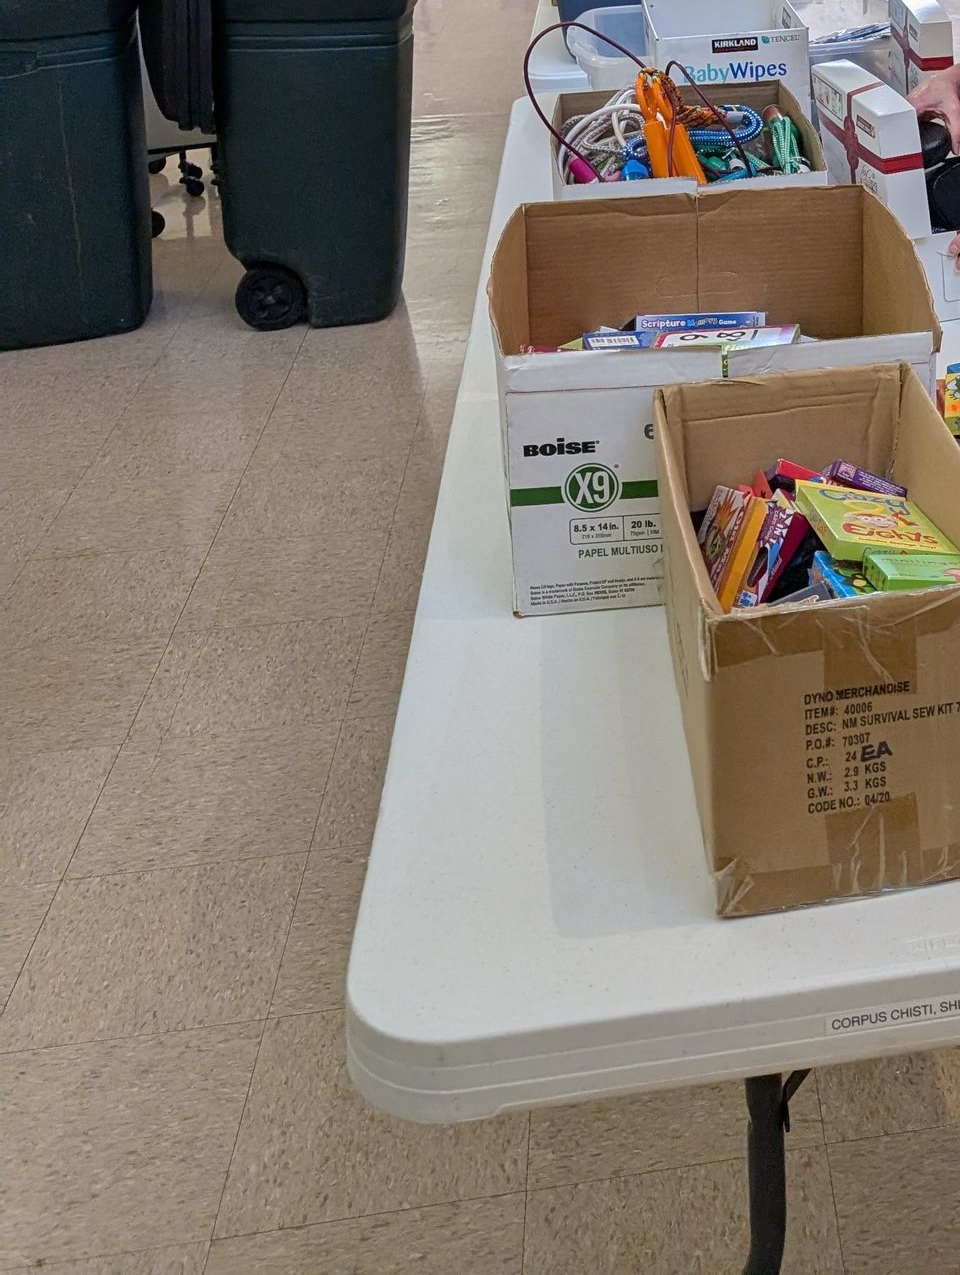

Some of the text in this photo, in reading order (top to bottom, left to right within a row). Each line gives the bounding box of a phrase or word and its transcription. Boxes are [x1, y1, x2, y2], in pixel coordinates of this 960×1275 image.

[713, 38, 756, 48] KIRKLAND
[642, 318, 686, 329] Scripture
[718, 318, 737, 326] Game
[574, 471, 610, 504] X9
[573, 524, 587, 533] 8.5
[598, 523, 608, 531] 14
[609, 522, 619, 530] in.
[631, 520, 656, 529] 20 lb.
[578, 544, 658, 559] PAPEL MULTIUSO
[804, 681, 910, 706] DYNO MERCHANDISE
[804, 702, 873, 720] ITEM#: 40006
[805, 722, 836, 736] DESC:
[842, 717, 858, 730] NM
[860, 709, 910, 727] SURVIVAL
[912, 705, 935, 720] SEW
[937, 702, 954, 714] KIT
[842, 732, 870, 747] 70307
[845, 751, 857, 763] 24
[860, 741, 893, 763] EA
[844, 766, 859, 778] 2.9
[864, 761, 886, 775] KGS
[844, 781, 858, 793] 3.3
[865, 776, 886, 790] KGS
[807, 799, 836, 814] CODE
[838, 796, 859, 809] NO.:
[831, 1011, 888, 1031] CORPUS
[890, 1003, 937, 1021] CHISTI,
